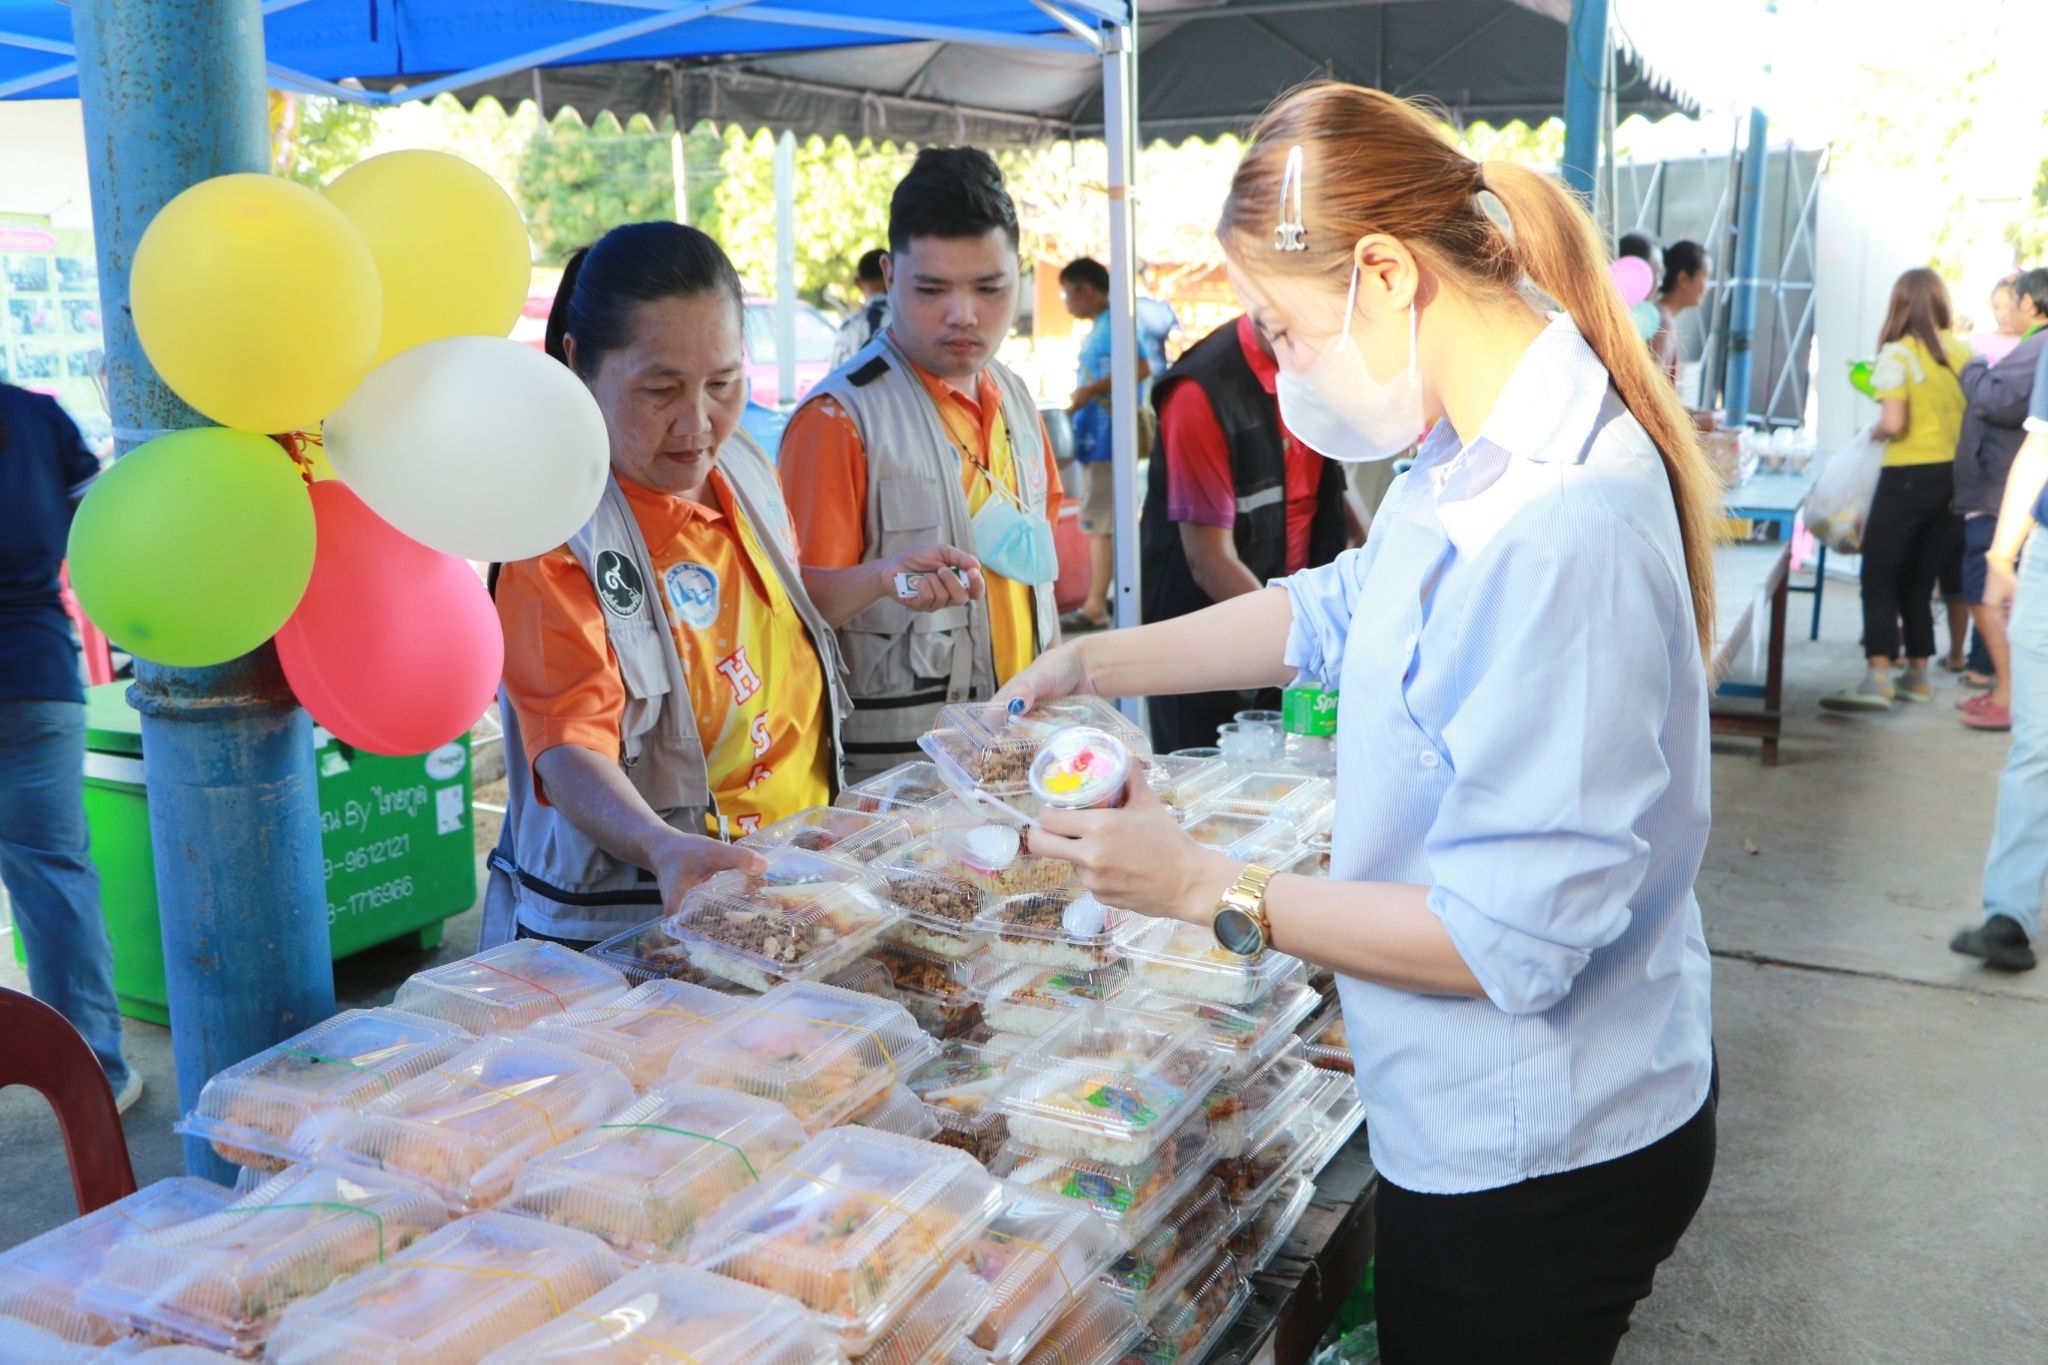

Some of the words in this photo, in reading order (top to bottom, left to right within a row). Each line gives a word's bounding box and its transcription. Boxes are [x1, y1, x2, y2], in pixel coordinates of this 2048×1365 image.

[1313, 694, 1339, 714] Spr
[345, 800, 371, 833] By
[323, 833, 410, 880] 9-9612121
